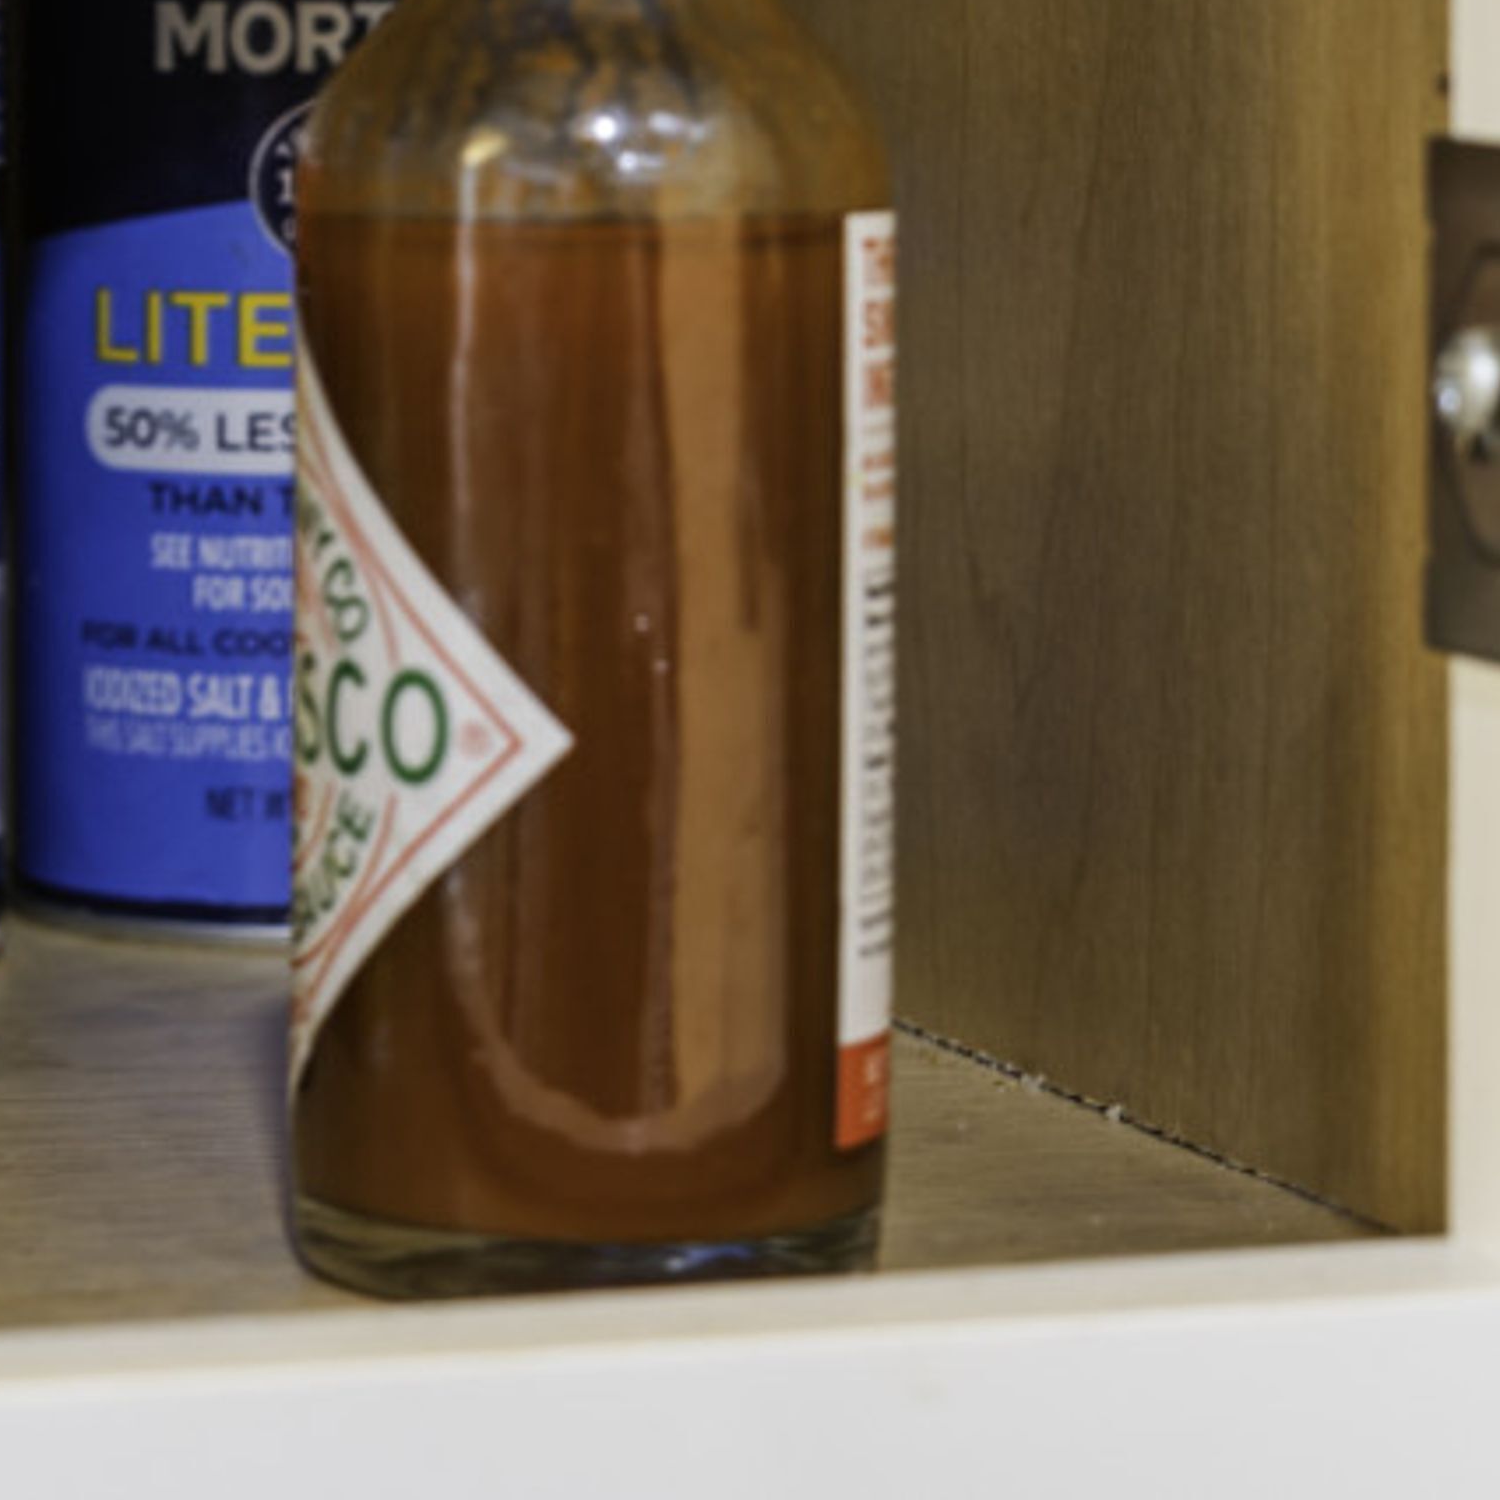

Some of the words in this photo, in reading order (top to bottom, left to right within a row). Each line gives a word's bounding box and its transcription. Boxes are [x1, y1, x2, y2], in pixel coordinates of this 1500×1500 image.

[95, 289, 294, 368] LITE
[103, 406, 199, 452] 50%
[149, 482, 264, 517] THAN
[149, 533, 193, 570] SEE
[192, 575, 246, 611] FOR
[144, 626, 206, 658] ALL
[187, 671, 254, 720] SALT
